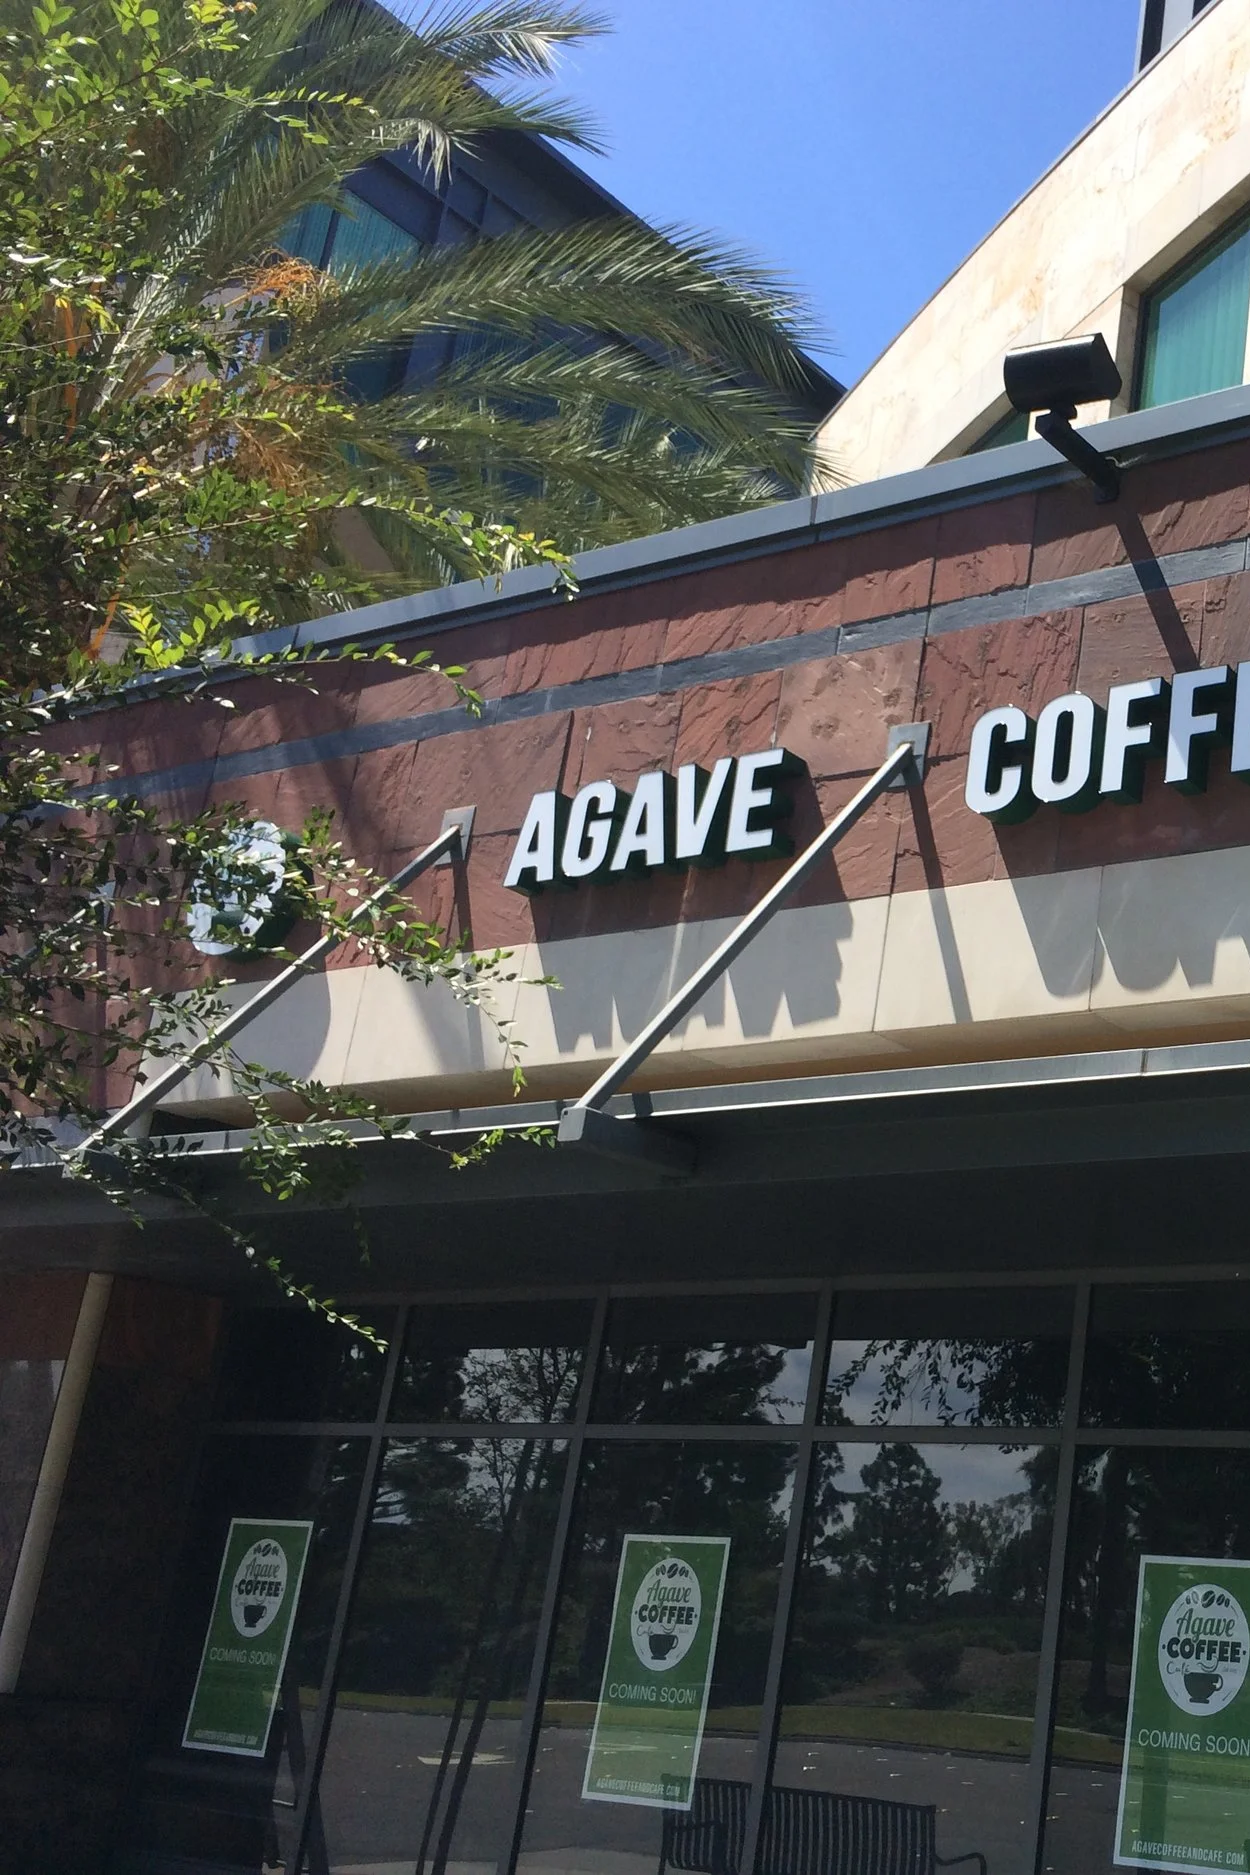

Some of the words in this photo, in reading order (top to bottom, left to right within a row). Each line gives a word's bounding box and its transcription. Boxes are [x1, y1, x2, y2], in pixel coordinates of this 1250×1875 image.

[503, 747, 788, 889] AGAVE
[245, 1557, 280, 1580] Agave
[237, 1579, 281, 1597] COFFEE
[647, 1579, 692, 1609] Agave
[638, 1604, 695, 1625] COFFEE
[1176, 1607, 1236, 1643] Agave
[209, 1647, 247, 1664] COMING
[248, 1650, 279, 1666] SOON
[1166, 1637, 1241, 1664] COFFEE
[609, 1683, 657, 1702] COMING
[660, 1686, 697, 1705] SOON!
[1138, 1729, 1201, 1752] COMING
[1131, 1840, 1245, 1866] AGAVECOFFEEANDCAFECOM
